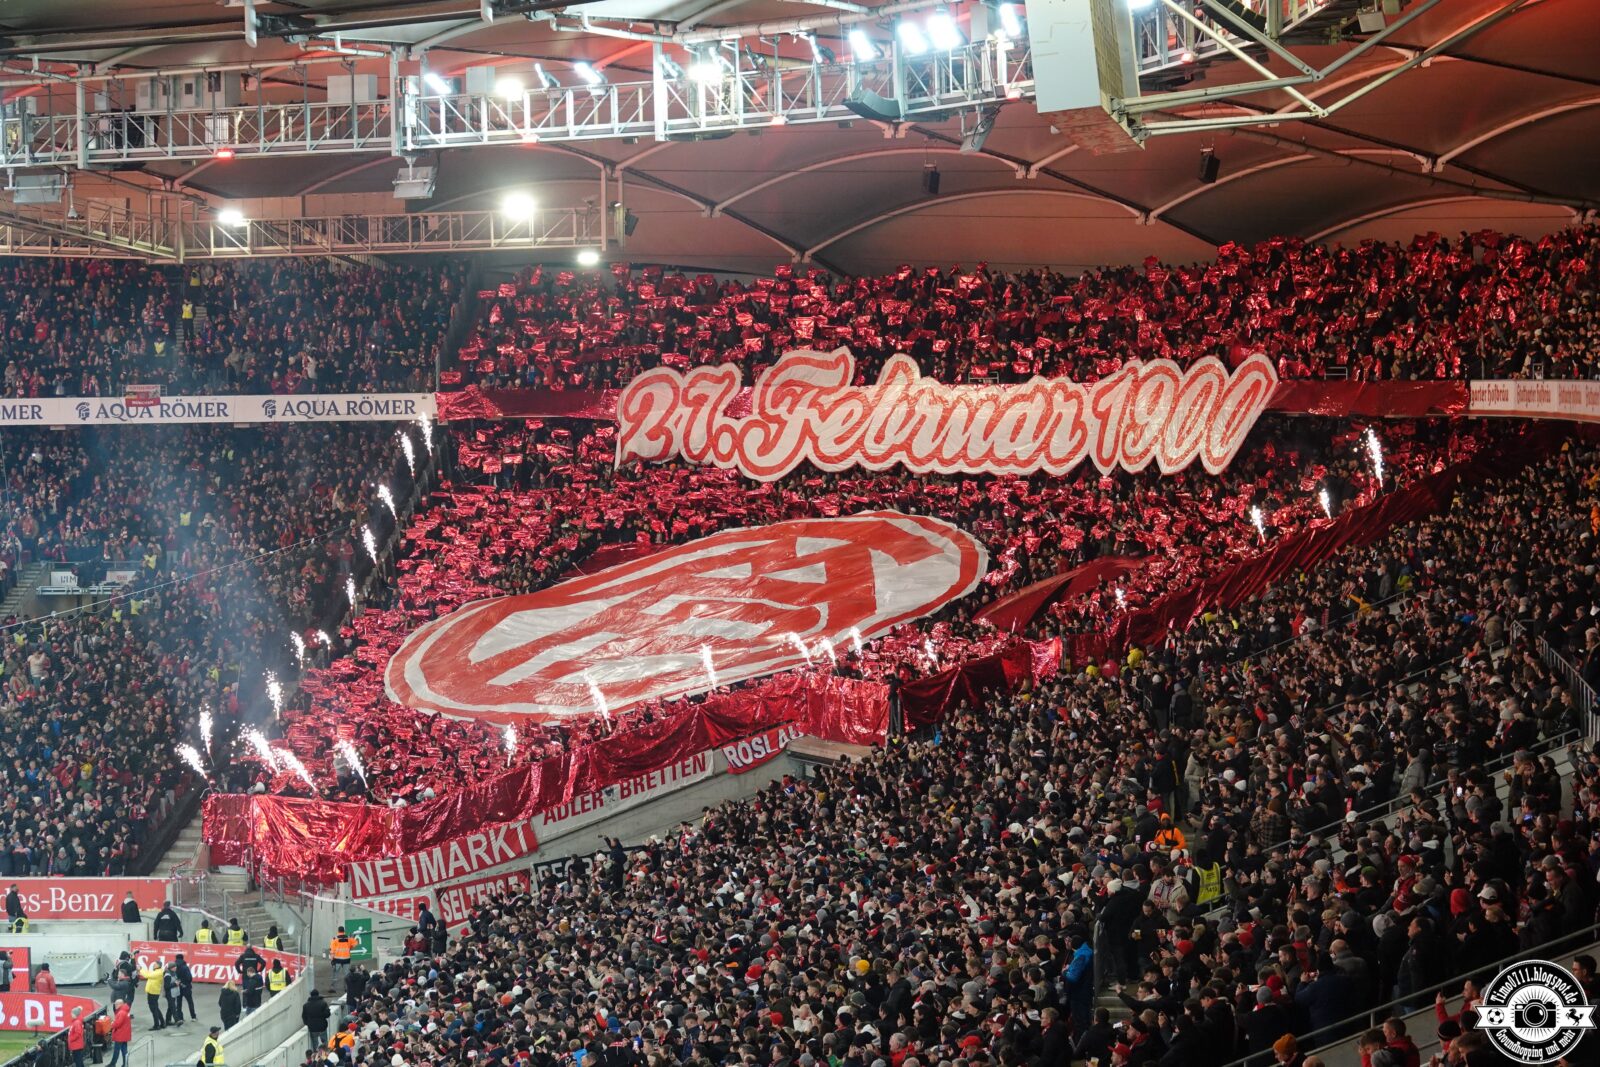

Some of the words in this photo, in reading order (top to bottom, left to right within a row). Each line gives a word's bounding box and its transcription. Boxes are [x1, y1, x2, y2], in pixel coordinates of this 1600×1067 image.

[0, 404, 43, 420] MER
[96, 403, 154, 421] AQUA
[160, 398, 229, 418] RÖMER
[282, 400, 340, 419] AQUA
[346, 396, 416, 416] RÖMER
[738, 347, 1090, 480] Februar
[1091, 354, 1277, 476] 1900
[543, 791, 604, 825] ADLER
[620, 753, 706, 799] BRETTEN
[352, 820, 529, 896] NEUMARKT
[0, 999, 65, 1028] .DE
